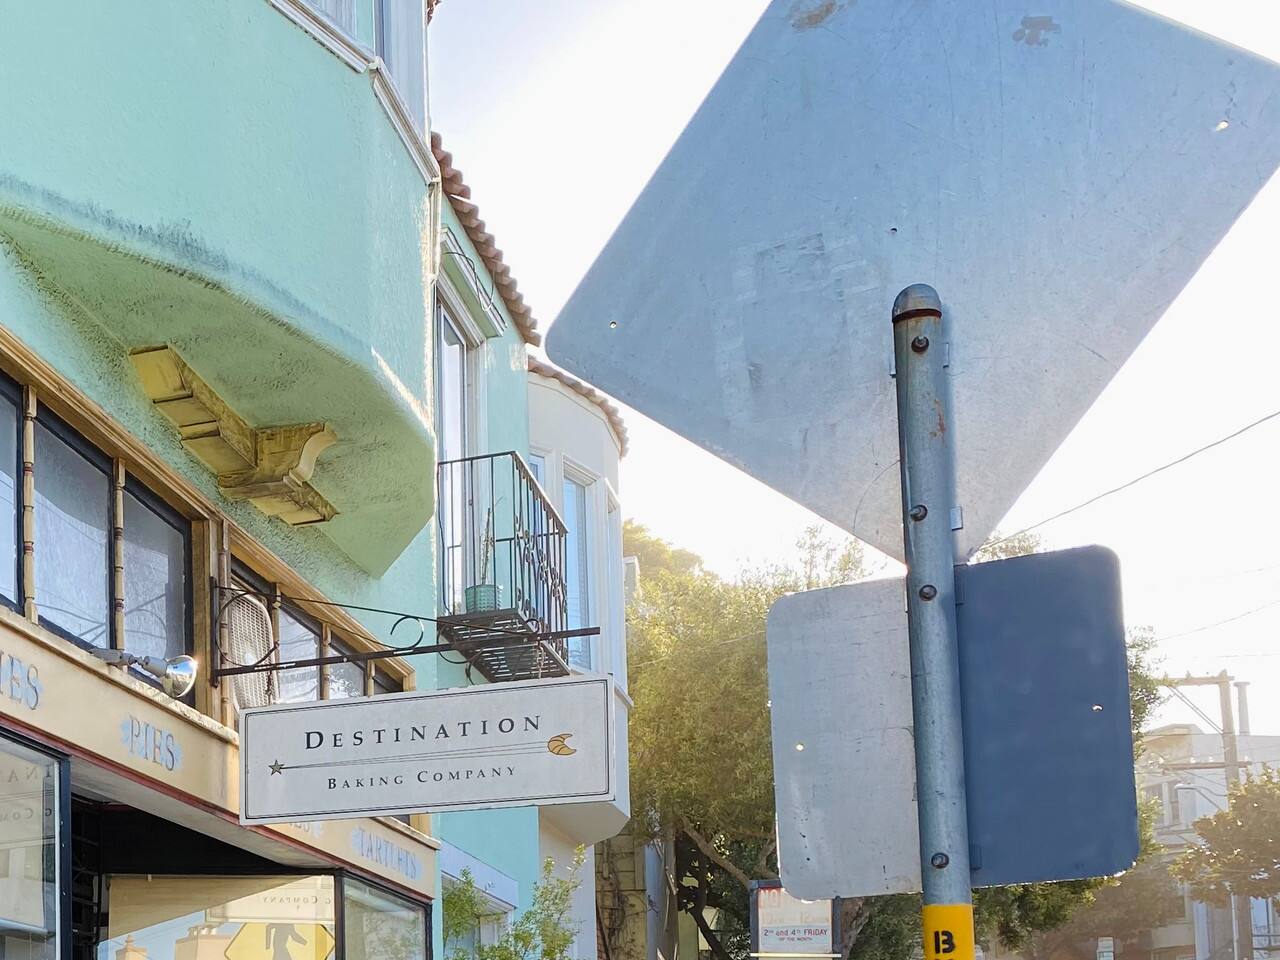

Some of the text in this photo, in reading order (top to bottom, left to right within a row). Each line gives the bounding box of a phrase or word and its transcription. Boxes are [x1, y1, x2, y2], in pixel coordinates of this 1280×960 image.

[128, 714, 176, 772] PIES
[305, 714, 541, 751] DESTINATION
[328, 765, 517, 790] BAKING COMPANY
